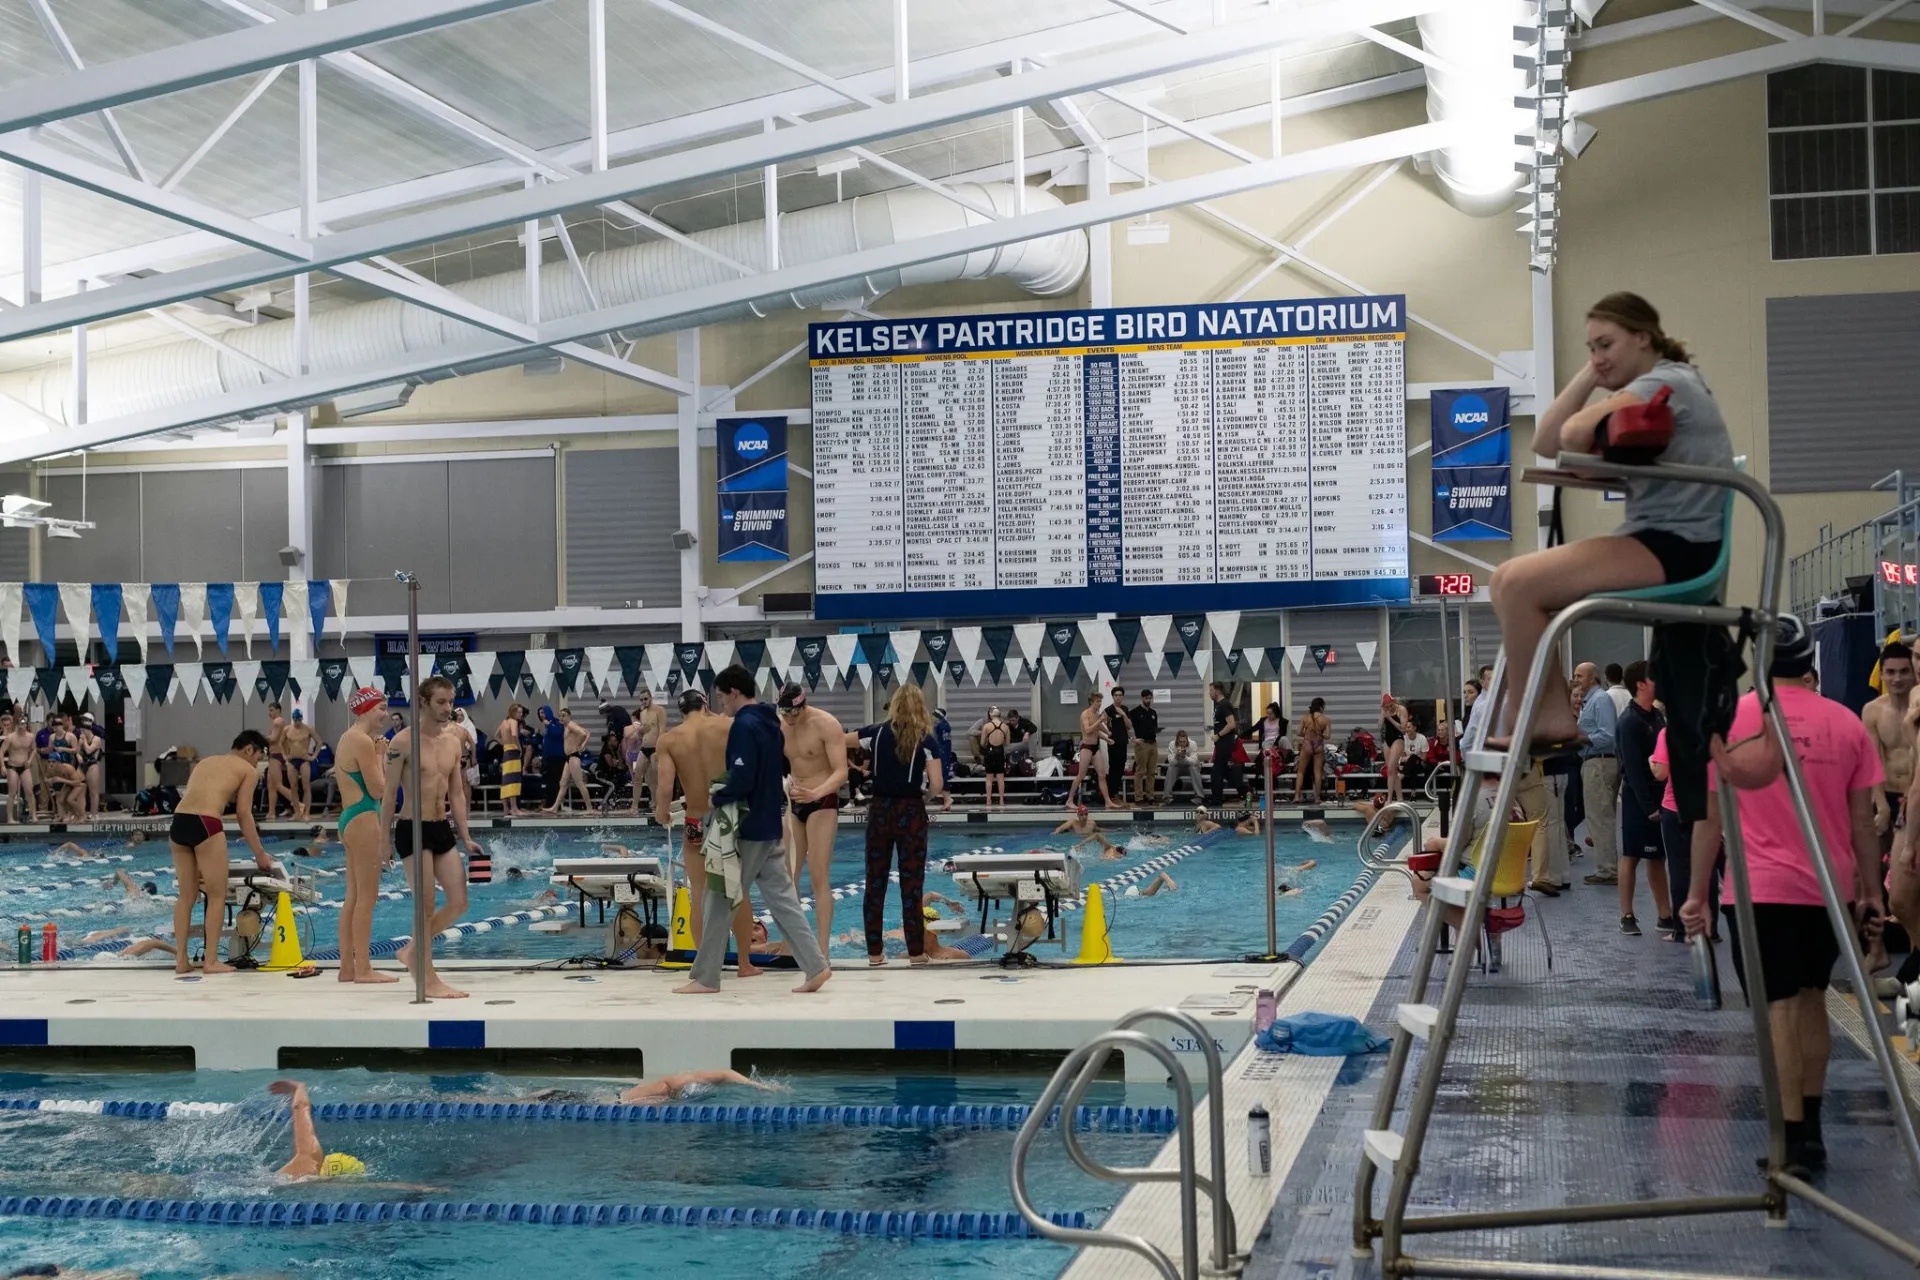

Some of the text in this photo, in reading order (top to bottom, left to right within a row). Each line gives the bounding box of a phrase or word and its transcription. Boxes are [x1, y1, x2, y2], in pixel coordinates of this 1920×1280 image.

[816, 302, 1396, 354] KELSEY PARTRIDGE BIRD NATATORIUM
[1455, 412, 1488, 424] NCAA
[738, 440, 768, 450] NCAA
[1451, 486, 1507, 497] SWIMMING
[1450, 497, 1493, 508] & DIVING
[736, 509, 785, 520] SWIMMING
[734, 520, 772, 531] & DIVING
[1435, 576, 1471, 594] 7:28
[387, 640, 464, 652] HATWICK
[93, 824, 123, 832] DEPTH
[676, 917, 685, 935] 2
[277, 925, 285, 943] 3
[1176, 1039, 1224, 1050] STAK
